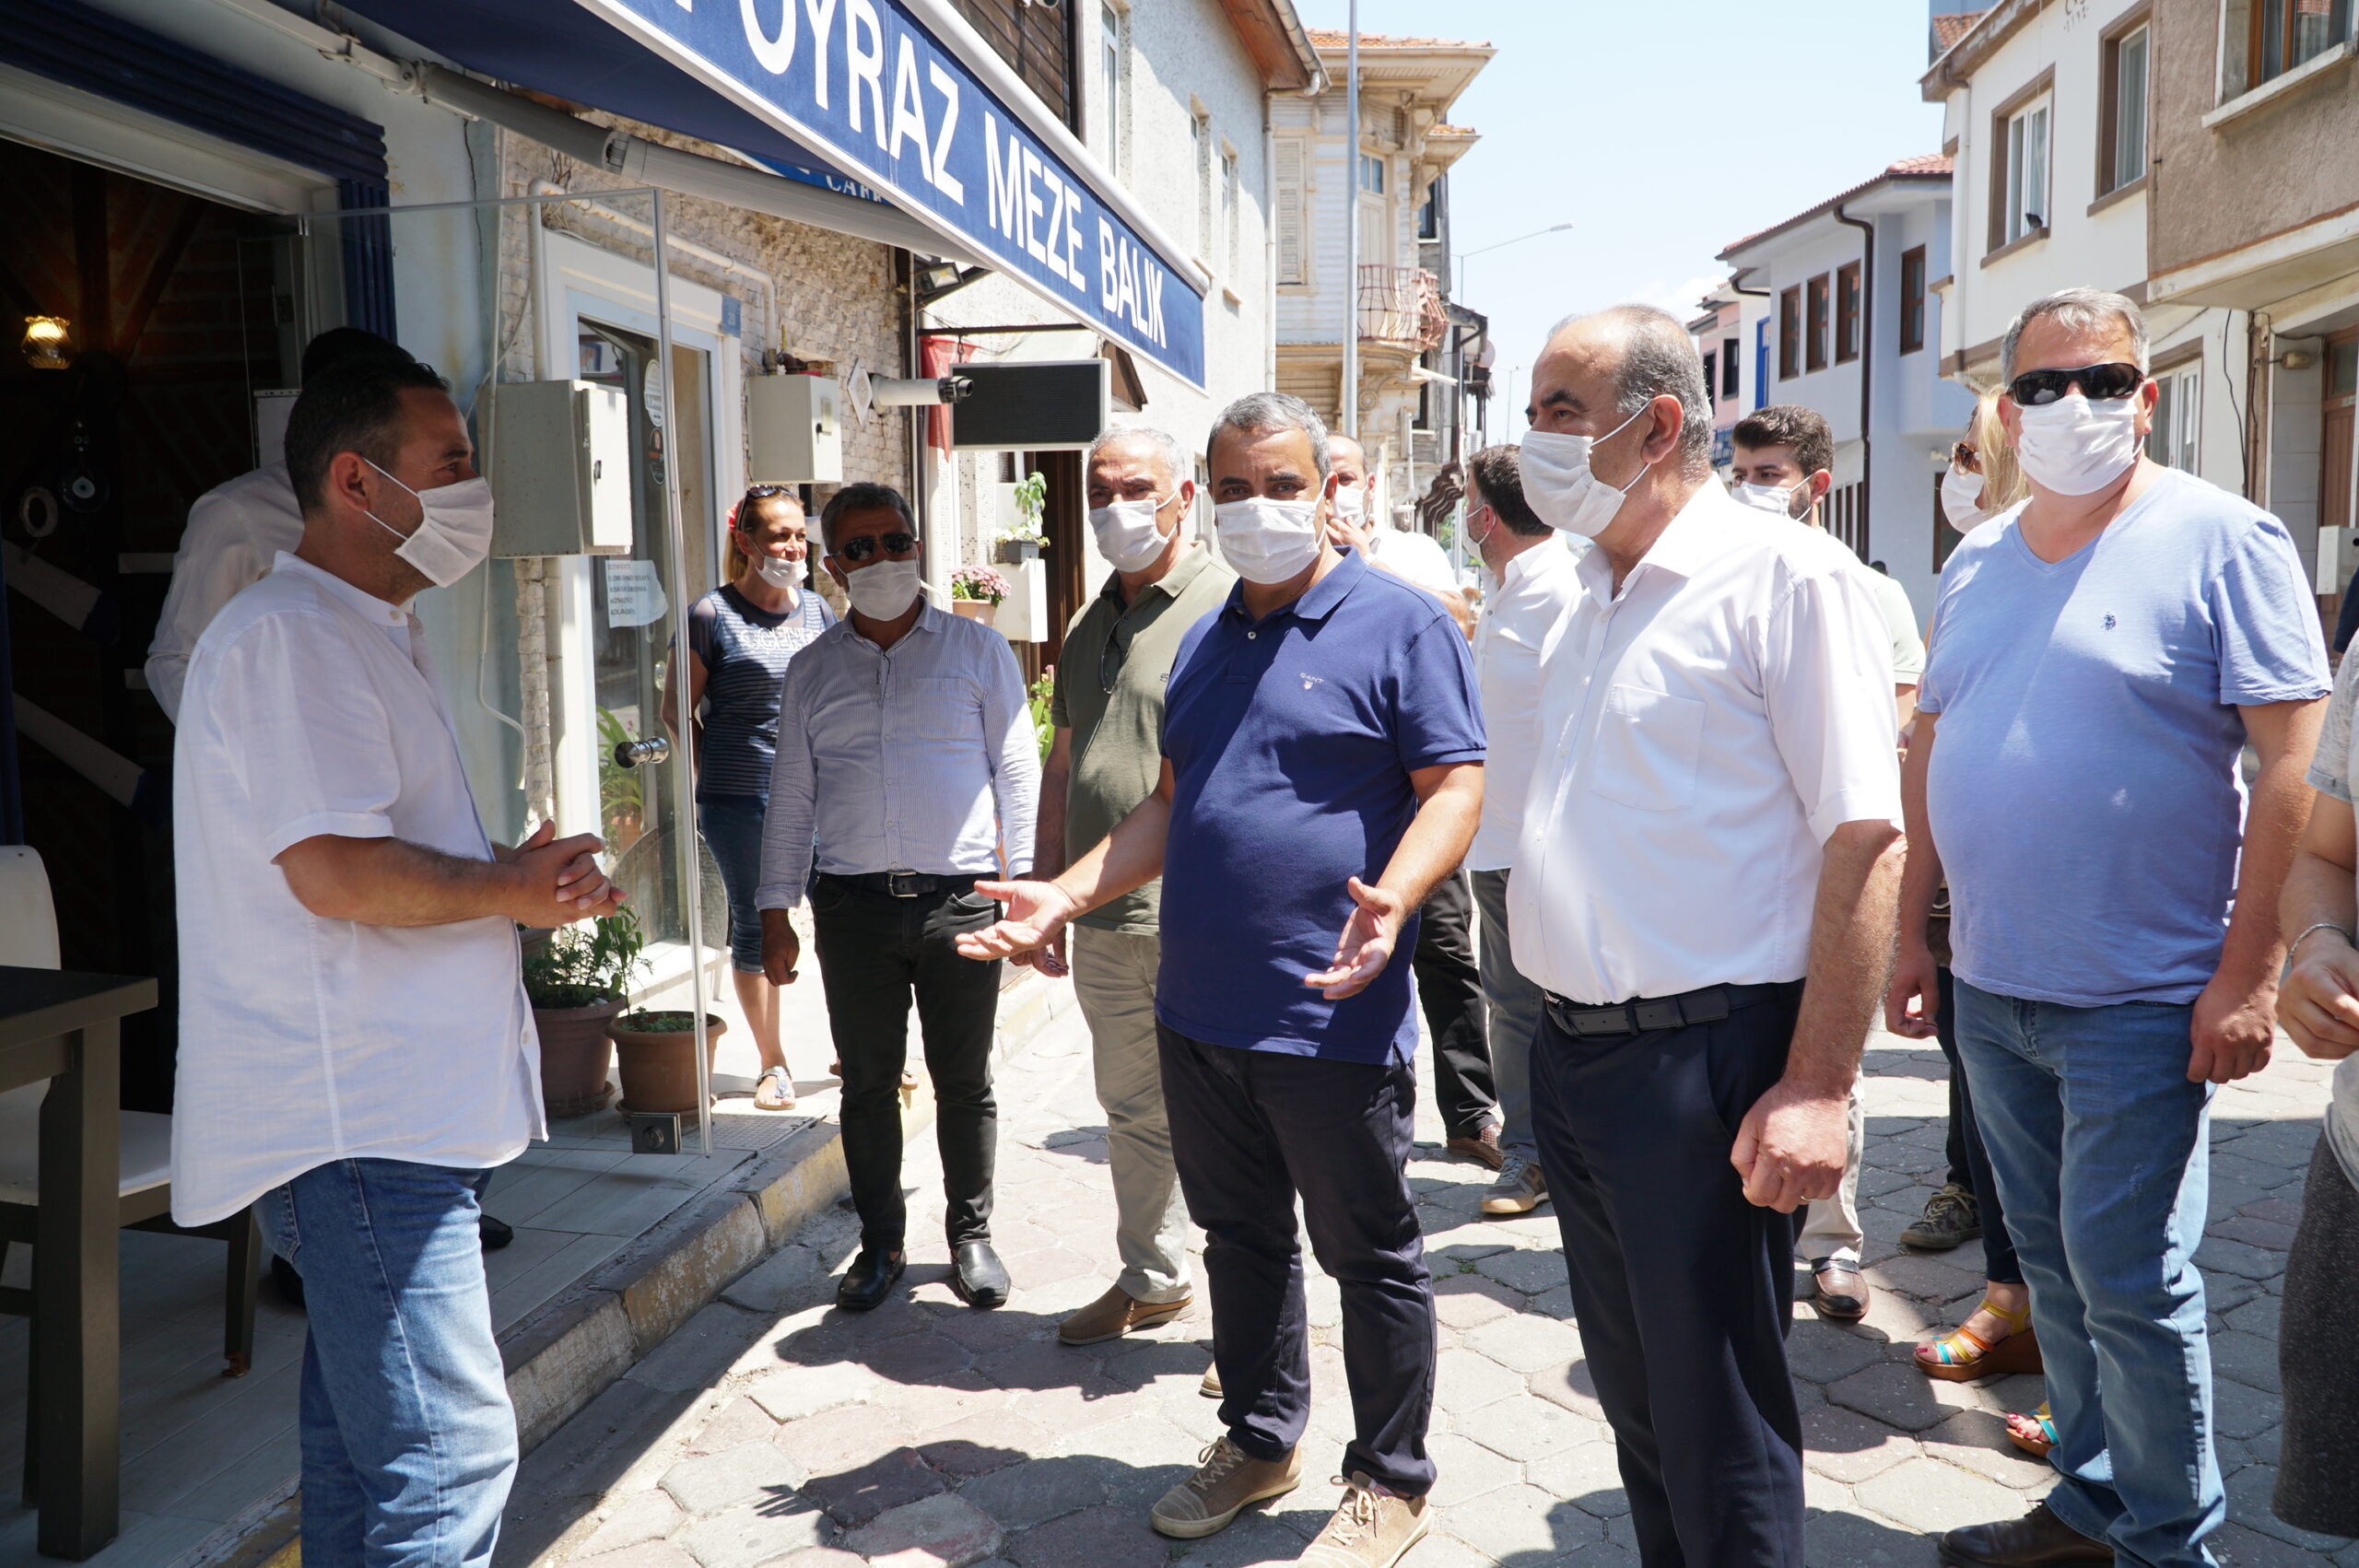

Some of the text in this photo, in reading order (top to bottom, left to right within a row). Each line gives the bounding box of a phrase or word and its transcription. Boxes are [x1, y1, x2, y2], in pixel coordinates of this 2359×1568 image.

[674, 0, 1167, 349] YRAZ MEZE BALIK
